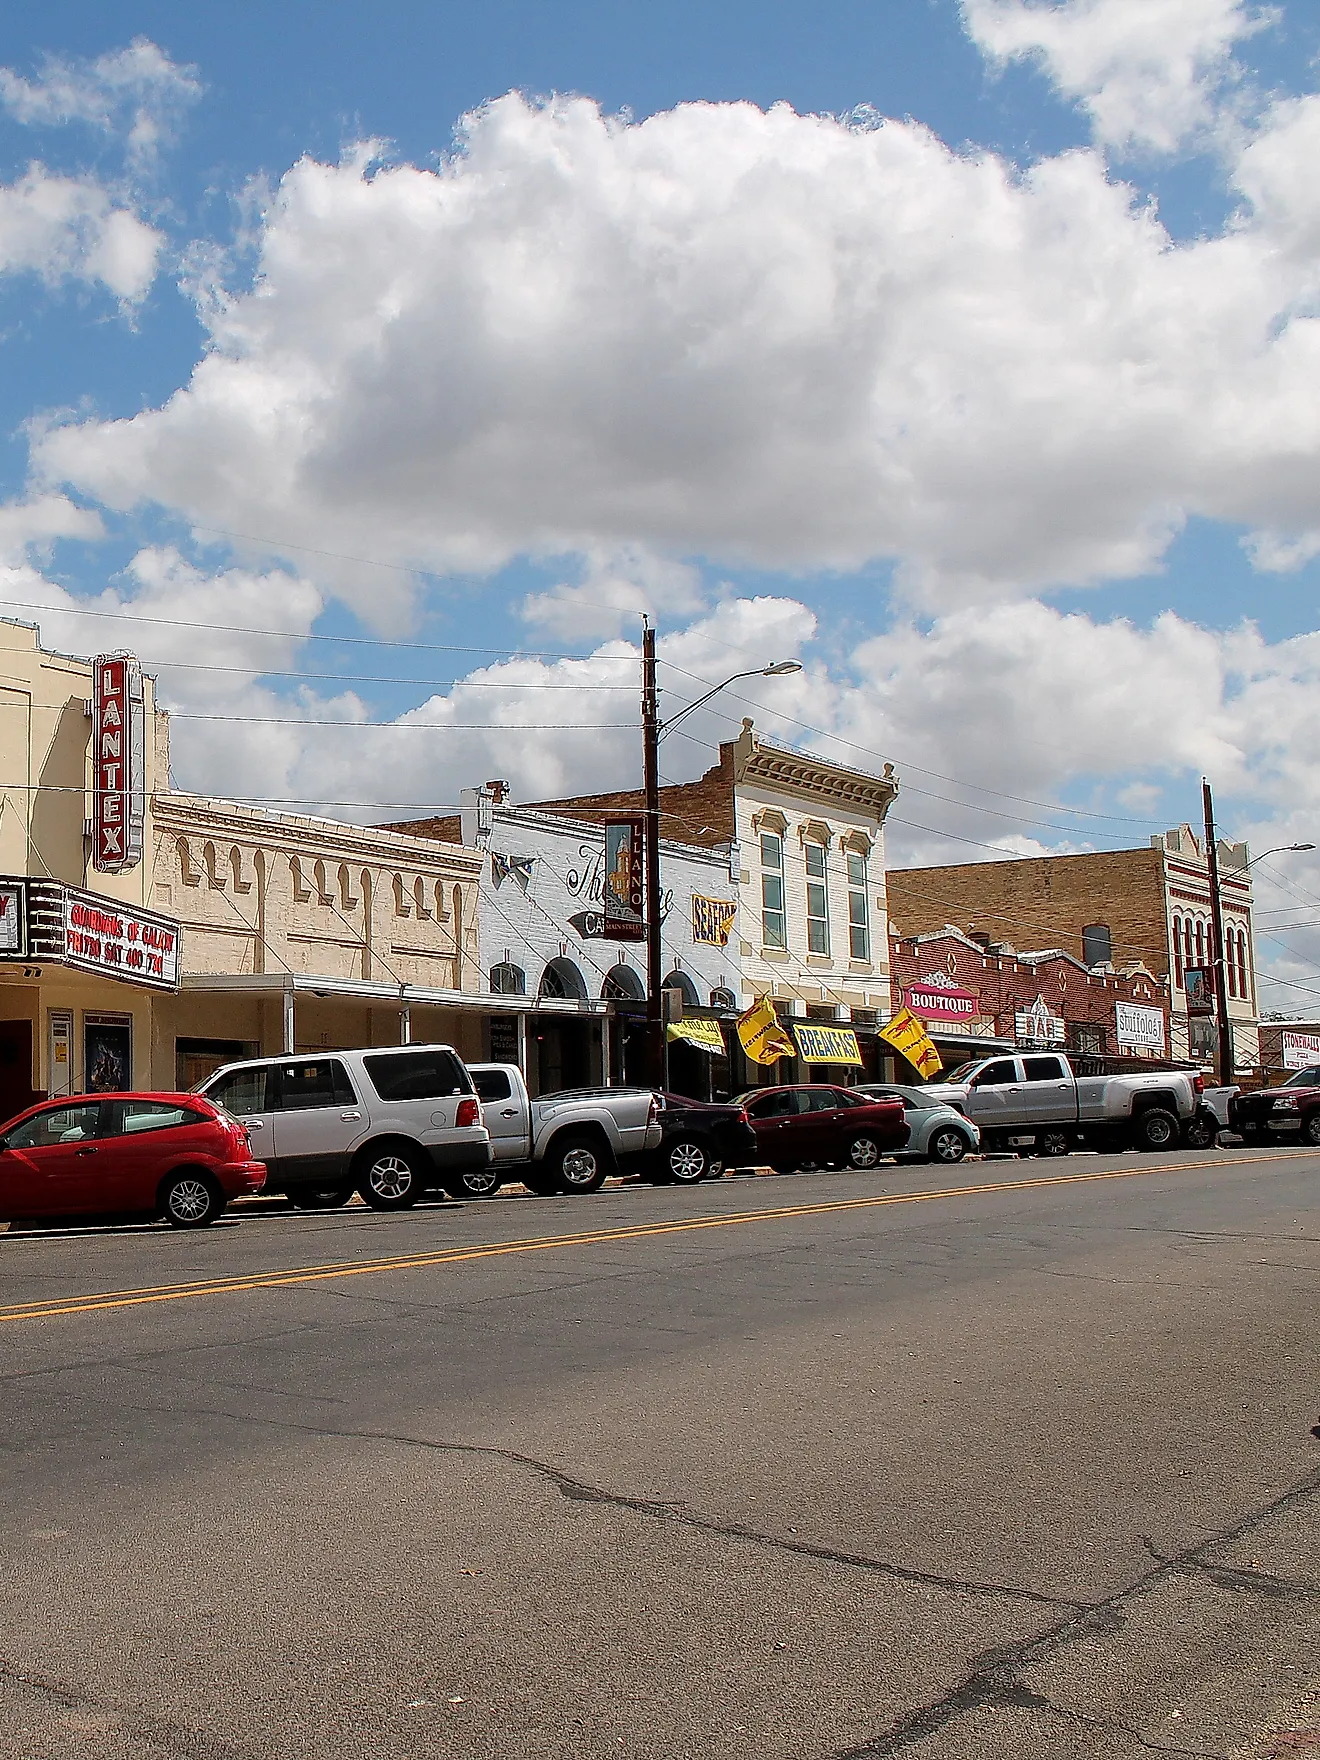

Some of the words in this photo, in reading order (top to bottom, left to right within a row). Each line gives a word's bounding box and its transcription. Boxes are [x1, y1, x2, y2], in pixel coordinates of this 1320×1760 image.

[102, 669, 122, 855] LANTEX
[631, 825, 643, 905] LLANO
[71, 903, 123, 939] GUARDIANS
[128, 921, 140, 942] OF
[142, 925, 175, 952] GALAXY
[66, 929, 84, 953] FRI
[104, 941, 123, 962] SAT
[147, 952, 163, 974] 730
[911, 993, 974, 1014] BOUTIQUE
[798, 1029, 860, 1058] BREAKFAST
[1026, 1015, 1055, 1038] BAR
